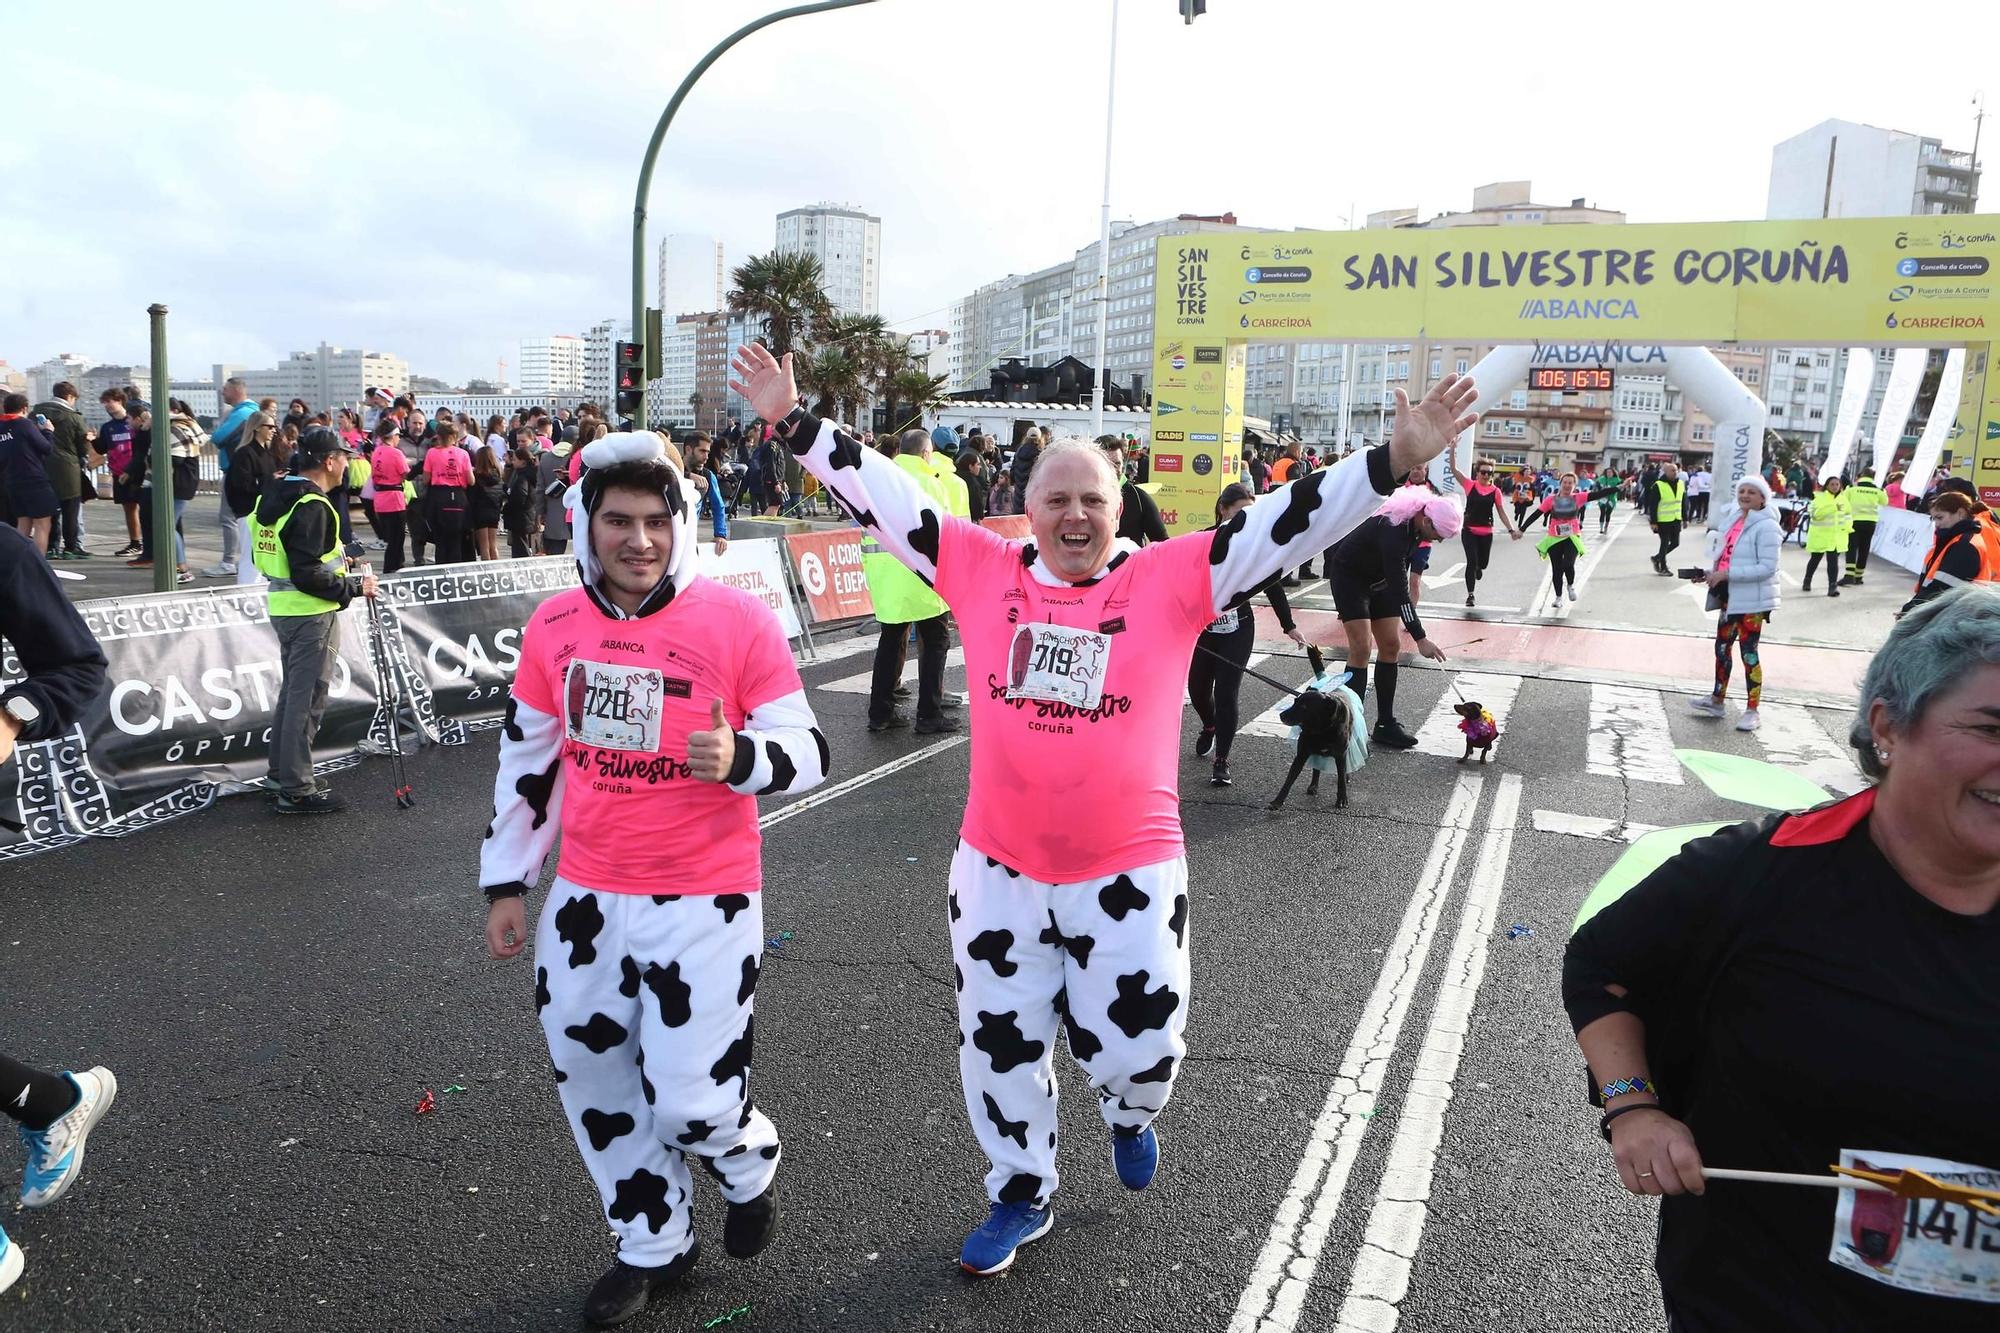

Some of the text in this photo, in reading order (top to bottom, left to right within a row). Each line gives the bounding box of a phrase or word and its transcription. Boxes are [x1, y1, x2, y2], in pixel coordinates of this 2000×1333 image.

[1178, 248, 1209, 264] SAN
[1177, 264, 1208, 283] SIL
[1344, 240, 1849, 290] SAN SILVESTRE CORUÑA
[1920, 263, 1948, 271] Concello
[1958, 263, 1982, 271] Coruña
[1177, 282, 1208, 299] VES
[1918, 287, 1942, 295] Puerto
[1963, 286, 1990, 294] Coruña
[1177, 299, 1208, 316] TRE
[1157, 431, 1183, 440] GADIS
[828, 544, 837, 567] A
[834, 567, 844, 595] É
[428, 627, 524, 681] CAS
[602, 639, 645, 654] ABANCA
[1035, 644, 1075, 677] 719
[595, 673, 621, 686] PABLO
[586, 686, 630, 721] 720
[1028, 721, 1074, 734] coruña
[595, 750, 692, 784] Silvestre
[592, 780, 633, 795] coruña
